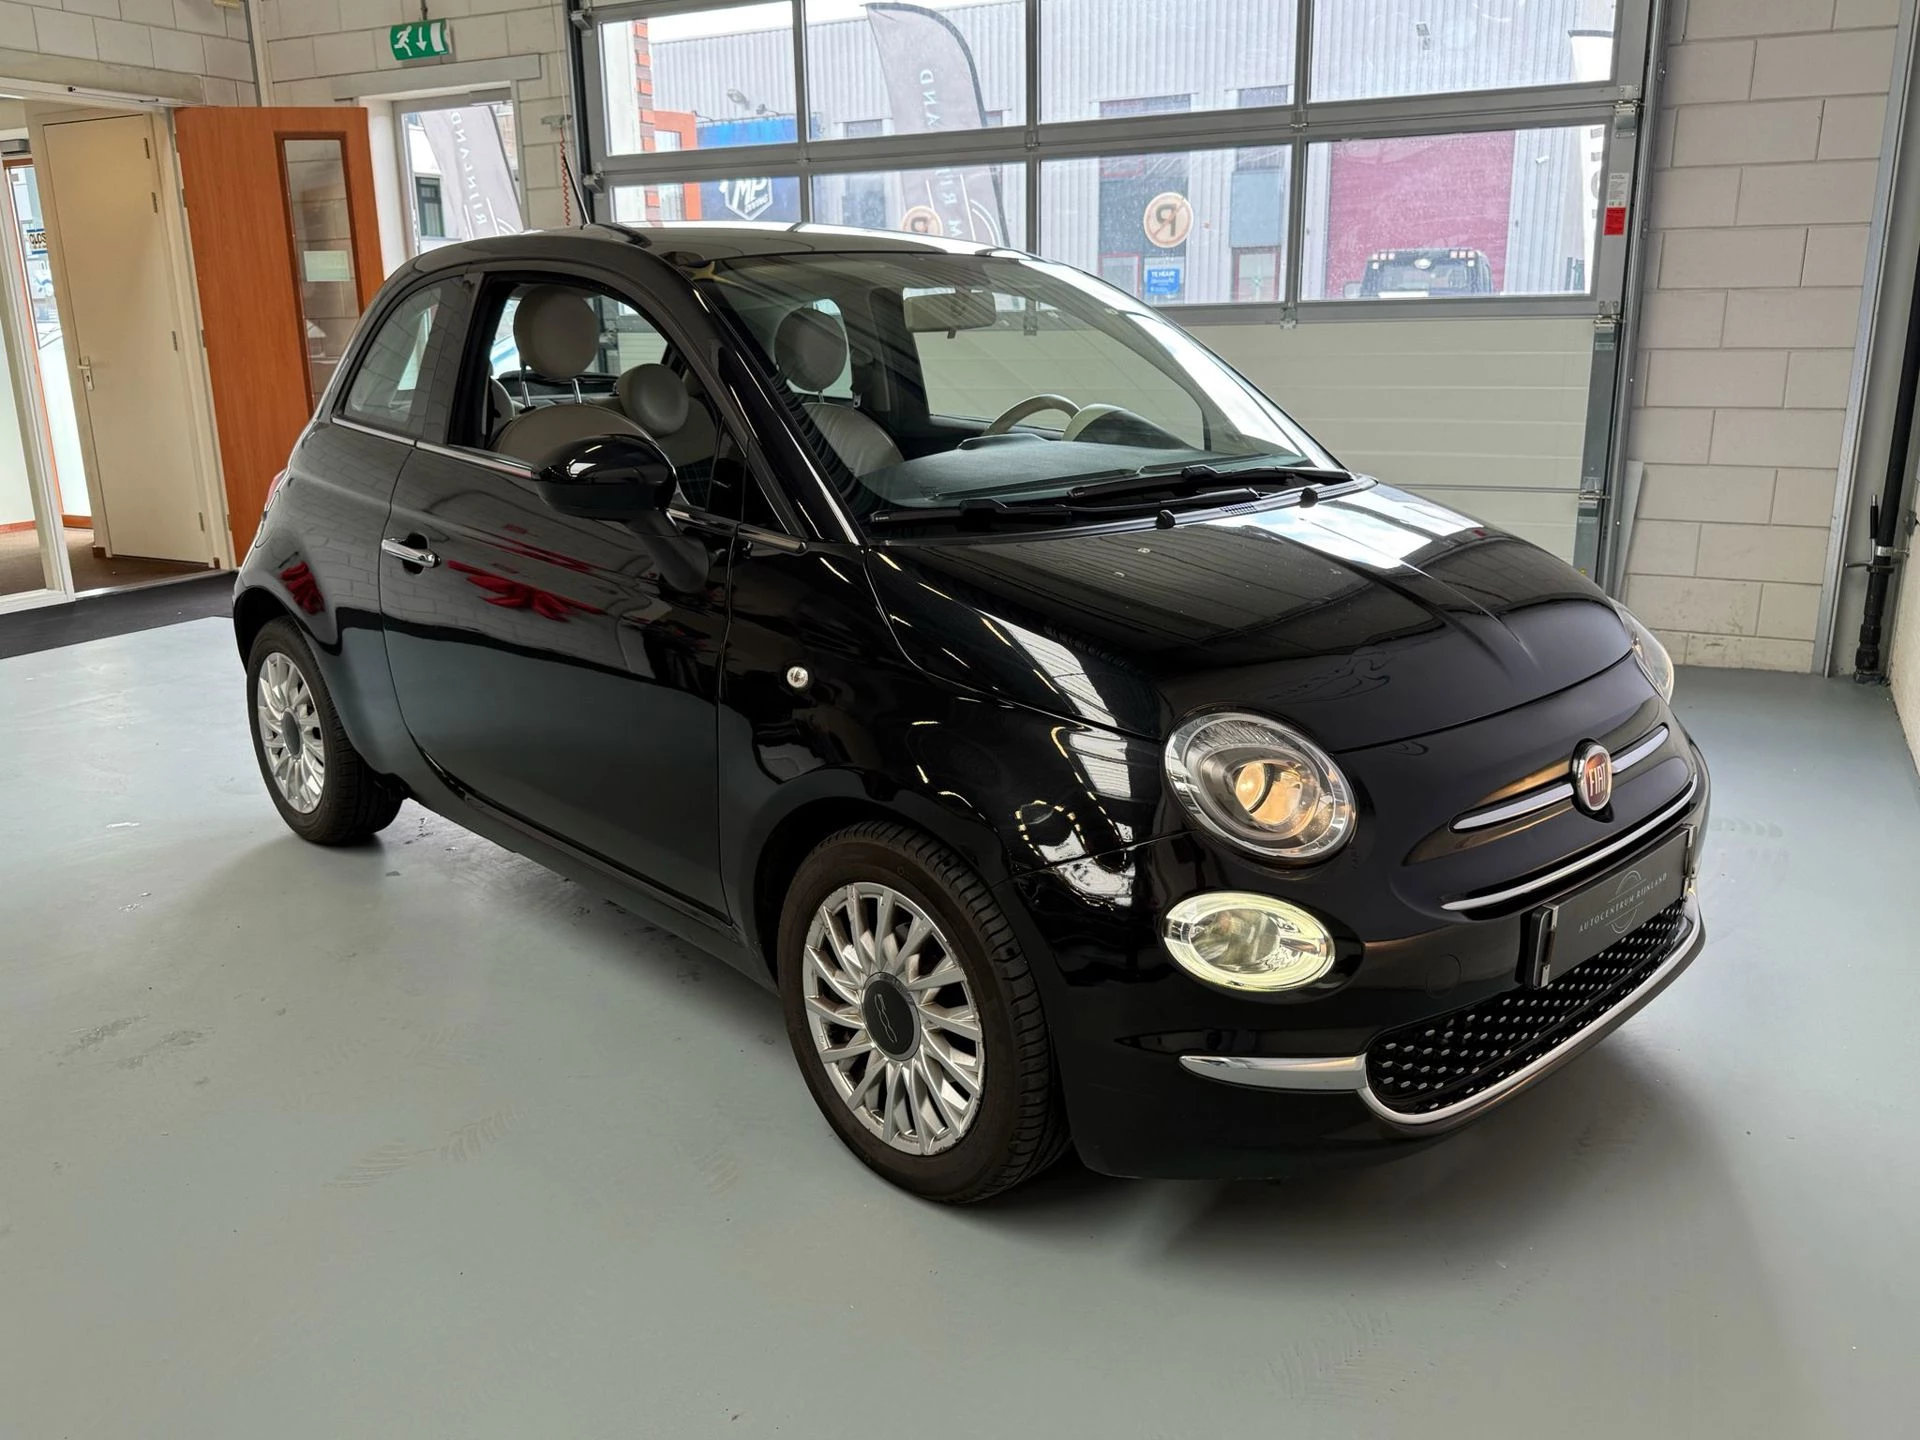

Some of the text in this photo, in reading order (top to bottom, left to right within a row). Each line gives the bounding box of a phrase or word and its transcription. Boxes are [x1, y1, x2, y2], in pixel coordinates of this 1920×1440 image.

[1589, 762, 1606, 797] FIAT
[1578, 872, 1668, 933] AUTOCENTRUM RIJNLAND
